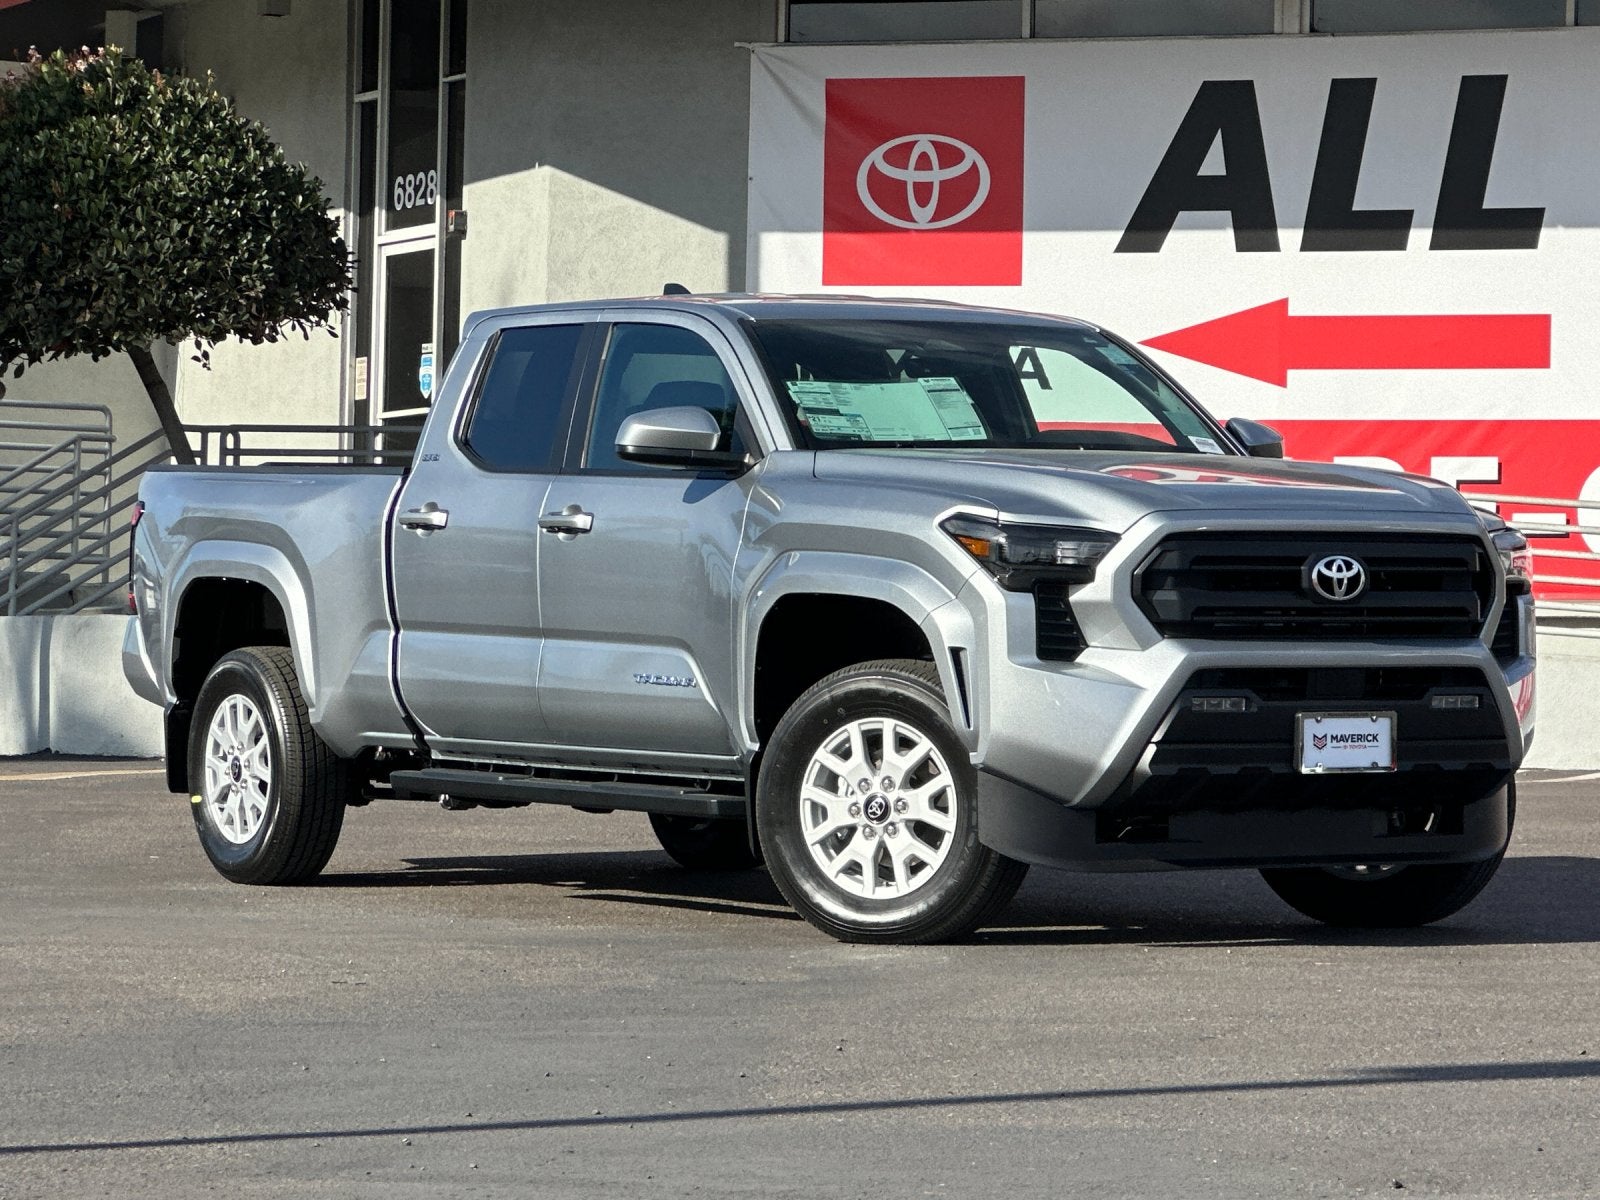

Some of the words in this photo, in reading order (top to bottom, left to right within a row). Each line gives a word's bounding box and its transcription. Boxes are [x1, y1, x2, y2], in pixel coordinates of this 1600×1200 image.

[1113, 74, 1545, 252] ALL
[394, 169, 437, 211] 6828
[1330, 733, 1379, 743] MAVERICK
